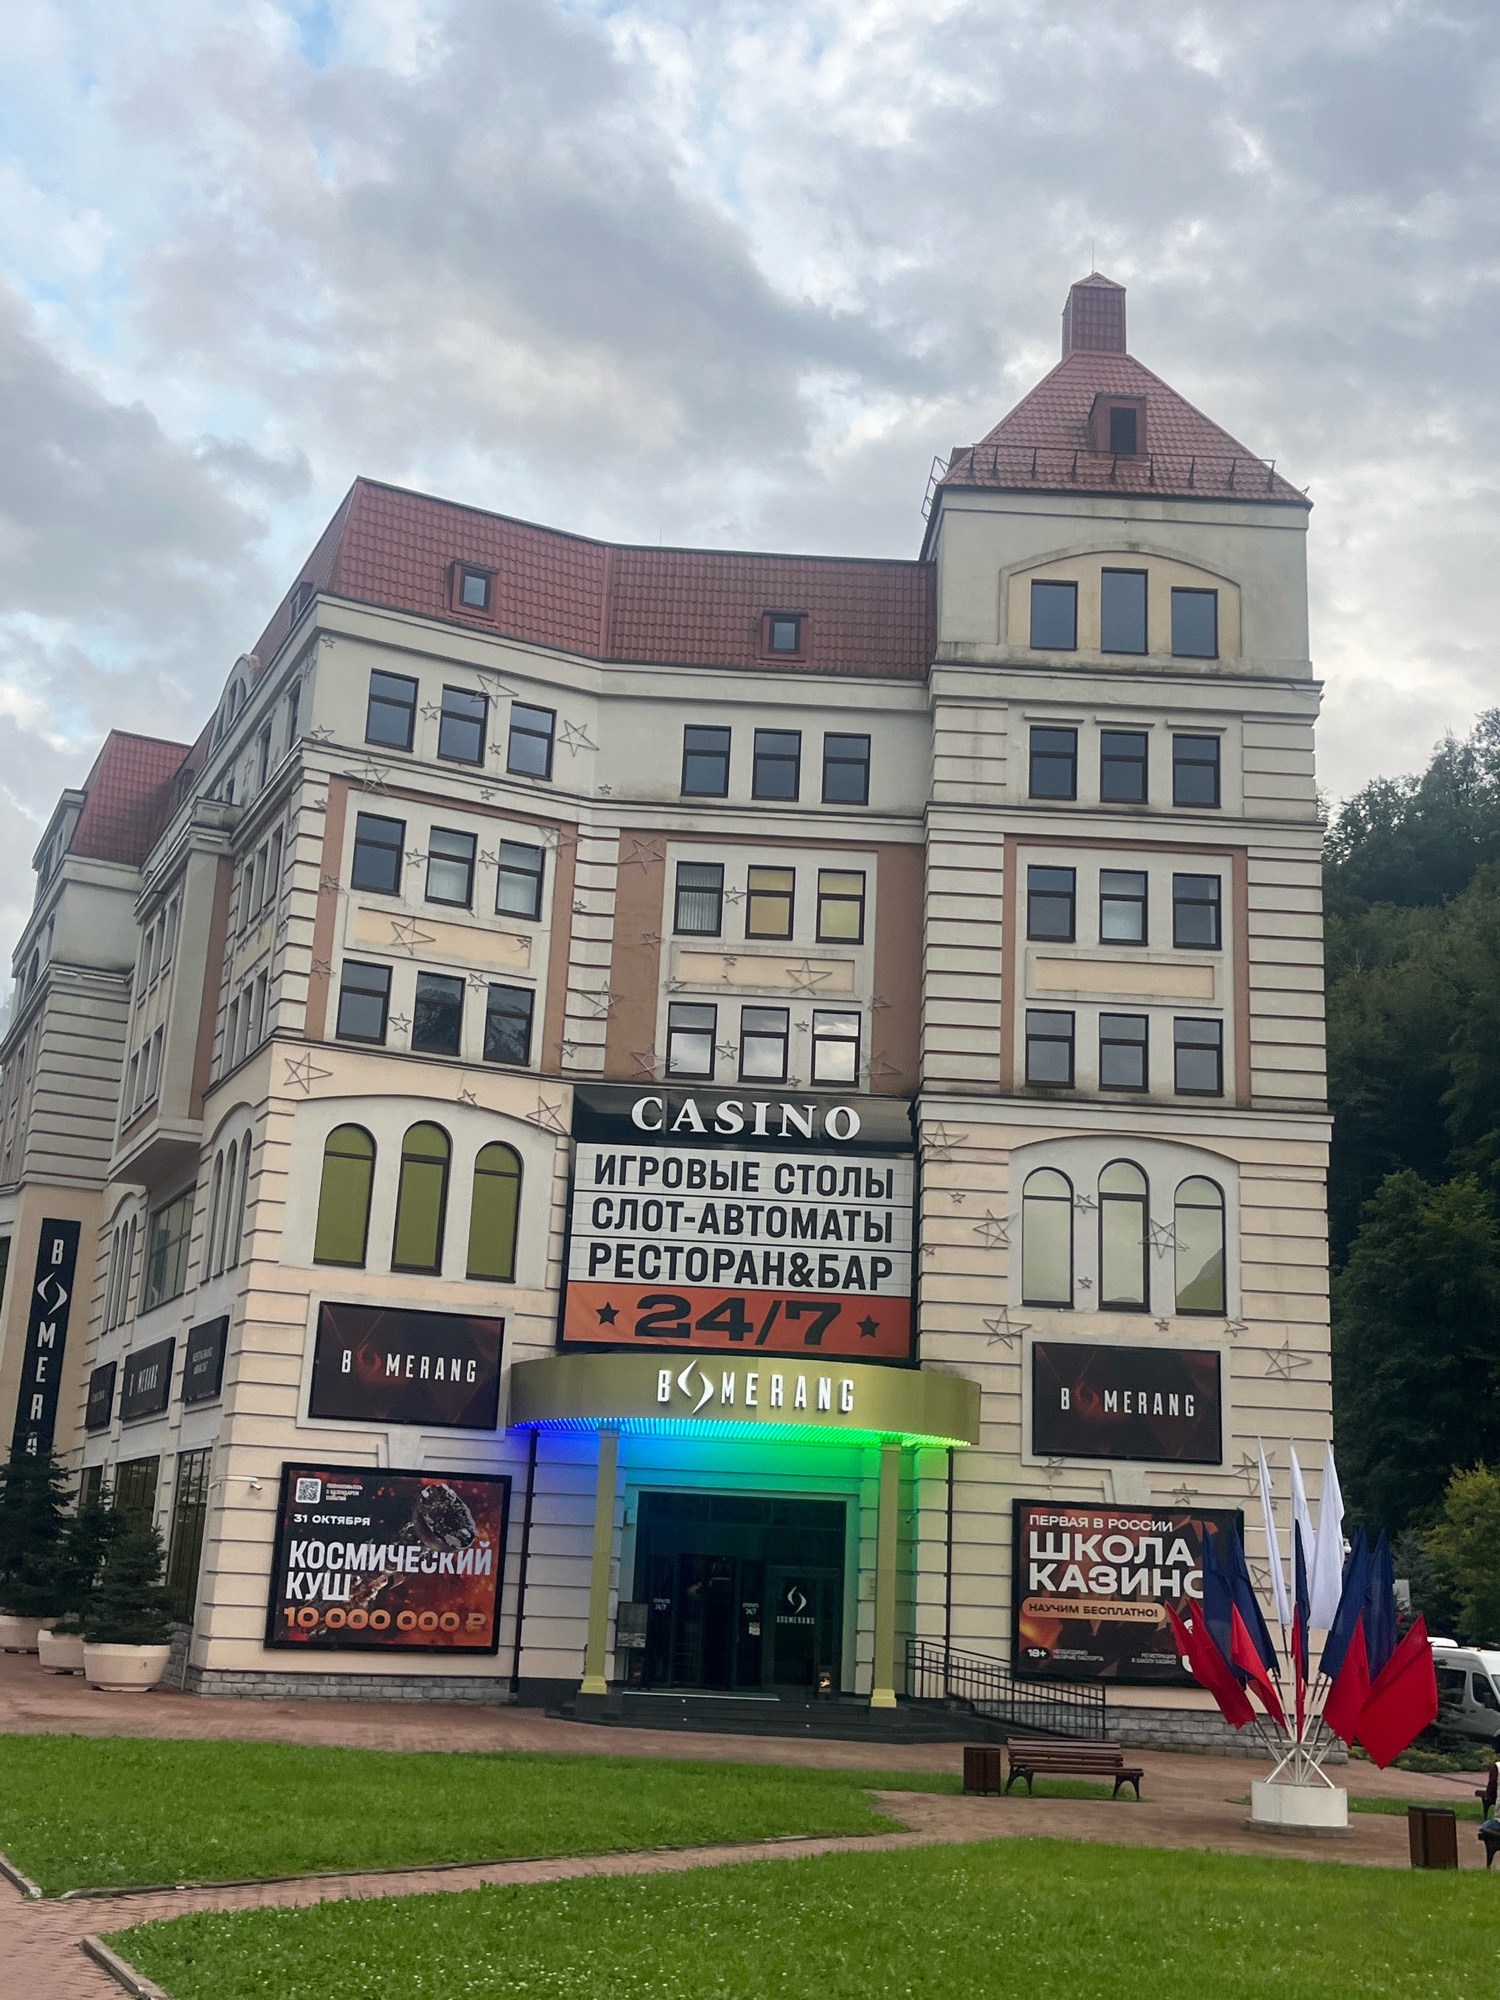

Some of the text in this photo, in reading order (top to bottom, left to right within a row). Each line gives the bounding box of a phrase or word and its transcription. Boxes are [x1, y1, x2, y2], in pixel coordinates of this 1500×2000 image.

[631, 1096, 862, 1141] CASINO
[594, 1153, 894, 1199] ИГРОВЫЕ СТОЛЫ
[591, 1197, 893, 1244] СЛОТ-АВТОМАТЫ
[588, 1242, 893, 1291] РЕСТОРАН&БАР
[634, 1293, 843, 1346] 24/7
[293, 1513, 371, 1527] 31 ОКТЯБРЯ
[1029, 1514, 1174, 1532] ПЕРВАЯ В РОССИИ
[288, 1540, 492, 1576] КОСМИЧЕСКИЙ
[1029, 1530, 1195, 1567] ШКОЛА
[285, 1571, 351, 1601] КУШ
[283, 1607, 319, 1628] 10
[324, 1608, 391, 1630] 000
[396, 1610, 461, 1632] 000
[1028, 1603, 1158, 1617] НАУЧИМ БЕСПЛАТНО!
[1027, 1648, 1047, 1658] 18+
